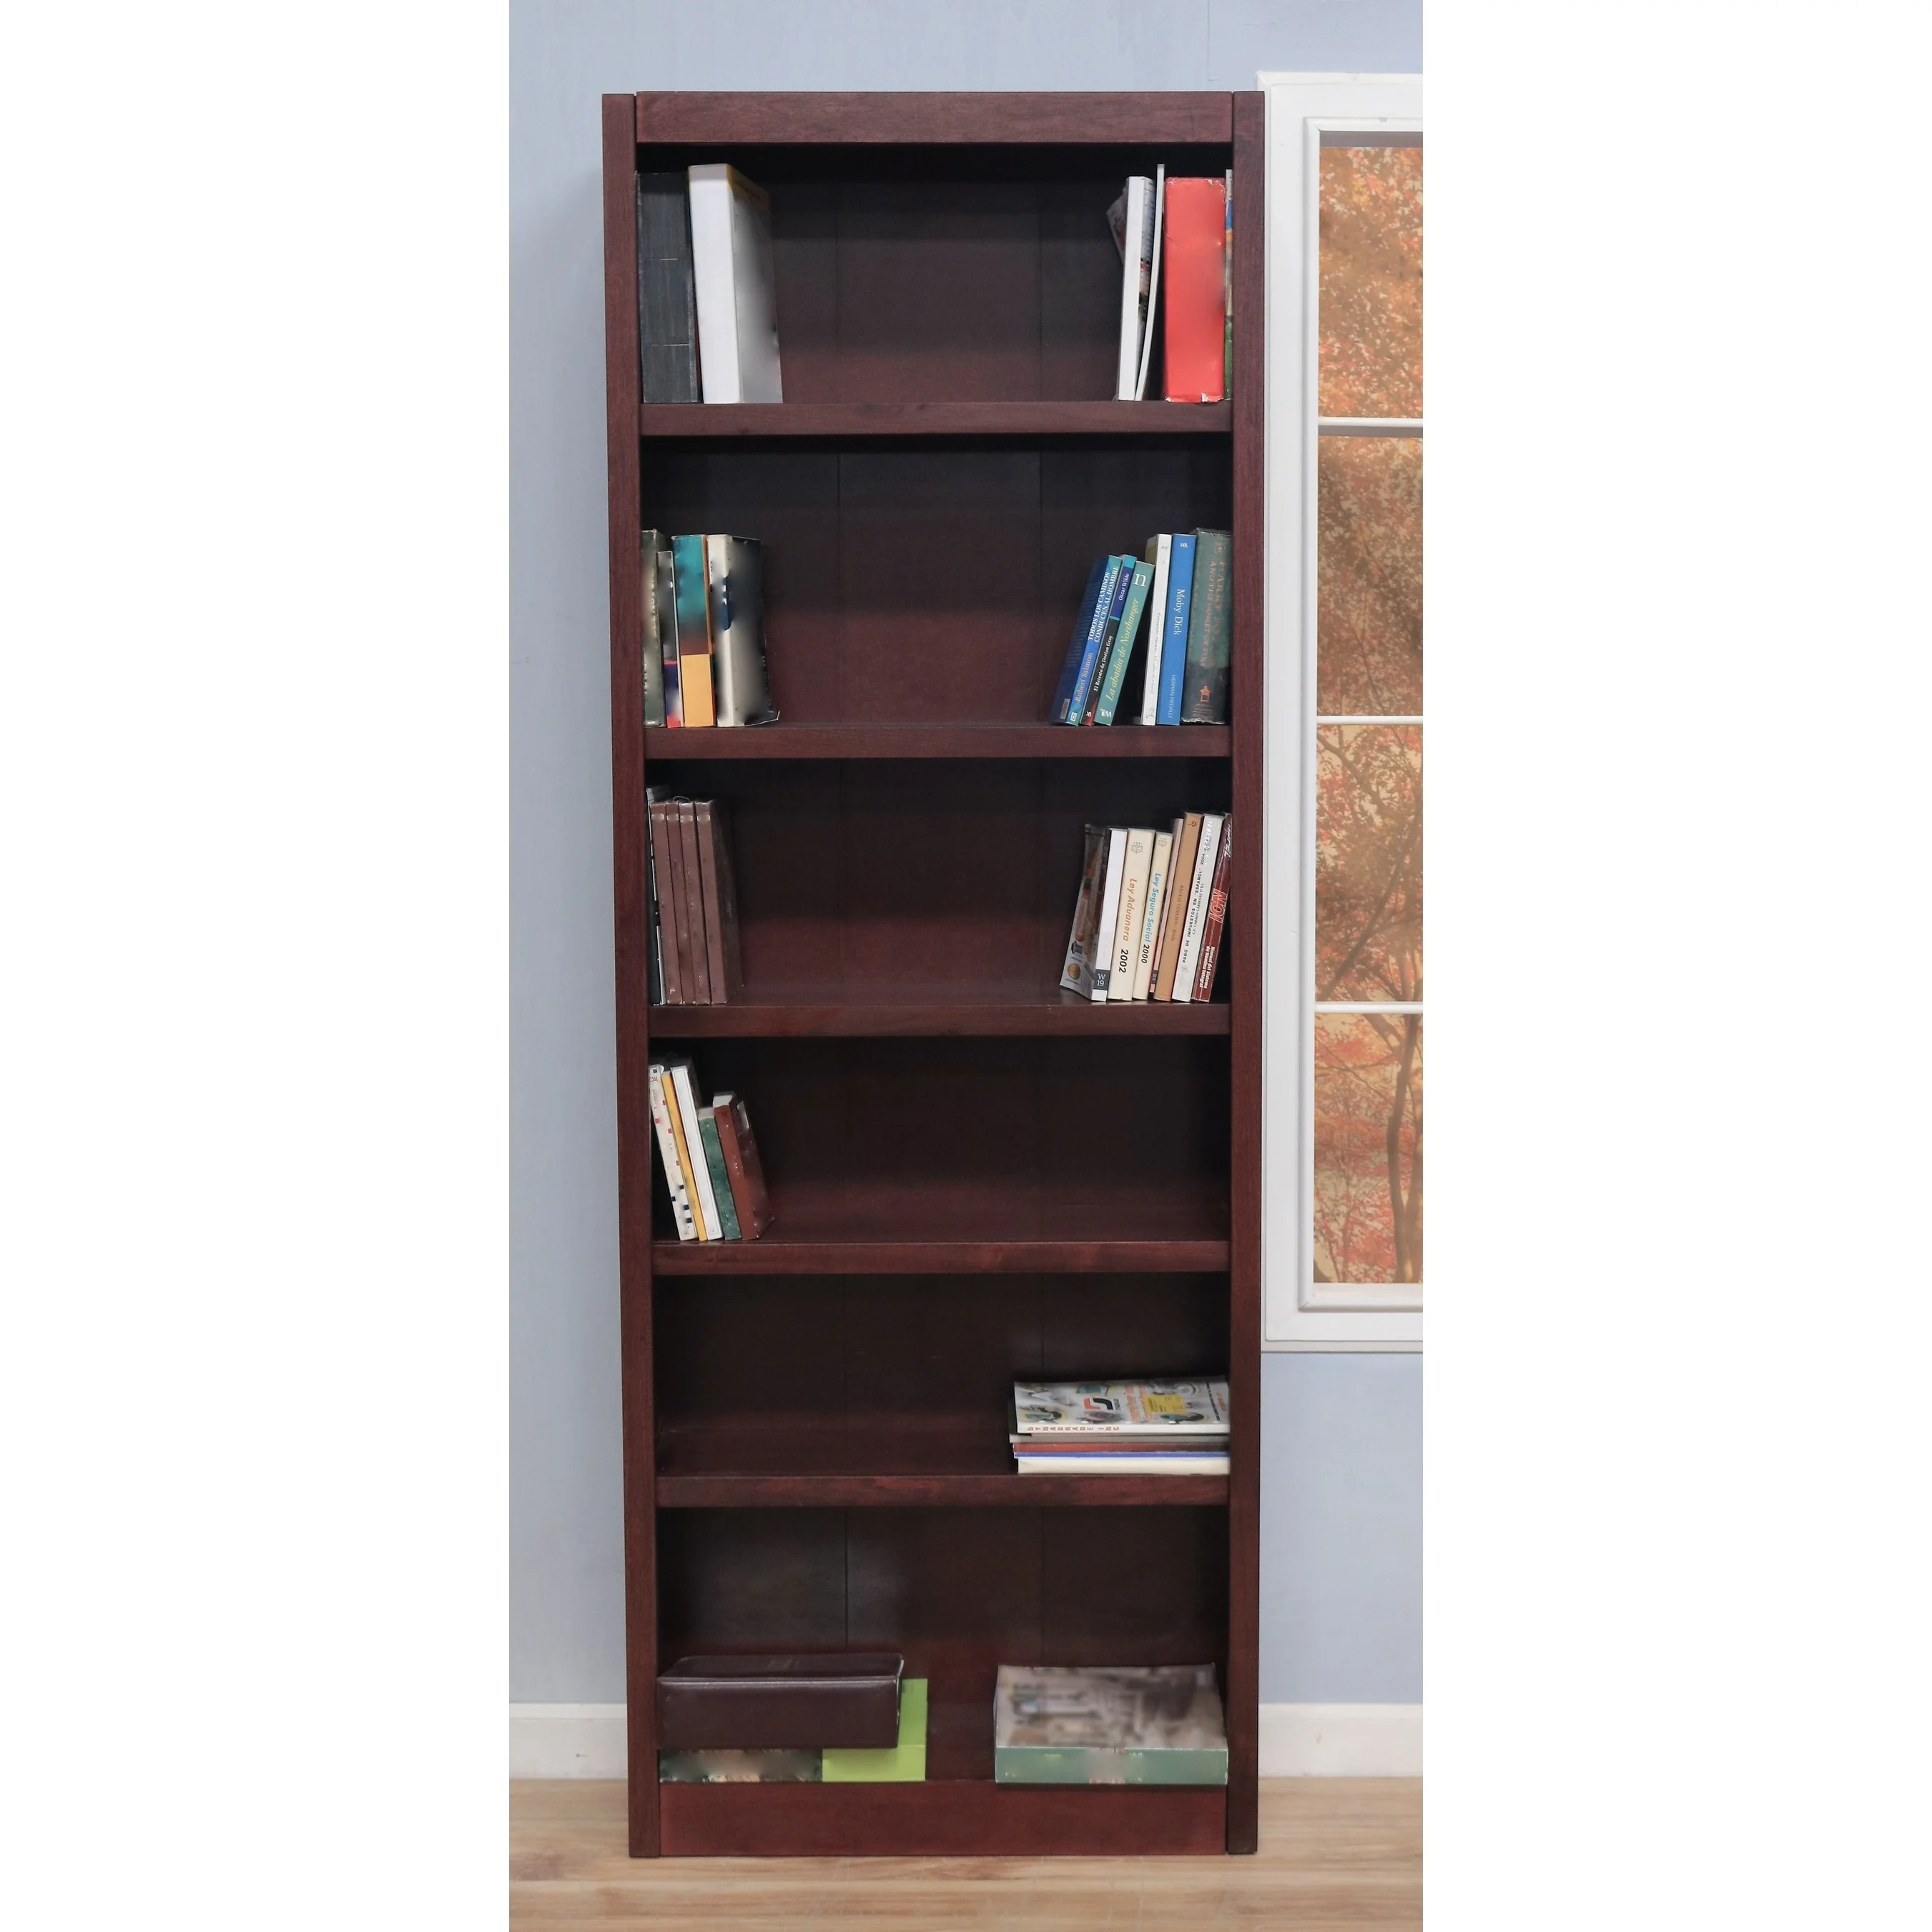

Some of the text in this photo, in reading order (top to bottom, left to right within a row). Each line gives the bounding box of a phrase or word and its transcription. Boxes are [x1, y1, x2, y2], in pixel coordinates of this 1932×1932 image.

[1088, 618, 1098, 641] TODOS
[1098, 571, 1110, 603] CAMINOS
[1094, 606, 1109, 643] CONDUCEN
[1107, 566, 1119, 594] HOMBRE
[1120, 598, 1139, 646] Northanger
[1173, 588, 1186, 635] Moby Dick
[1118, 647, 1126, 657] de
[1075, 653, 1093, 702] Robert Salmon
[1105, 688, 1115, 701] La
[1118, 878, 1138, 973] Ley Aduanera 2002
[1140, 872, 1161, 964] Ley Seguro Social 2000
[1187, 908, 1196, 937] IMPUESTOS
[1209, 888, 1228, 924] NOI
